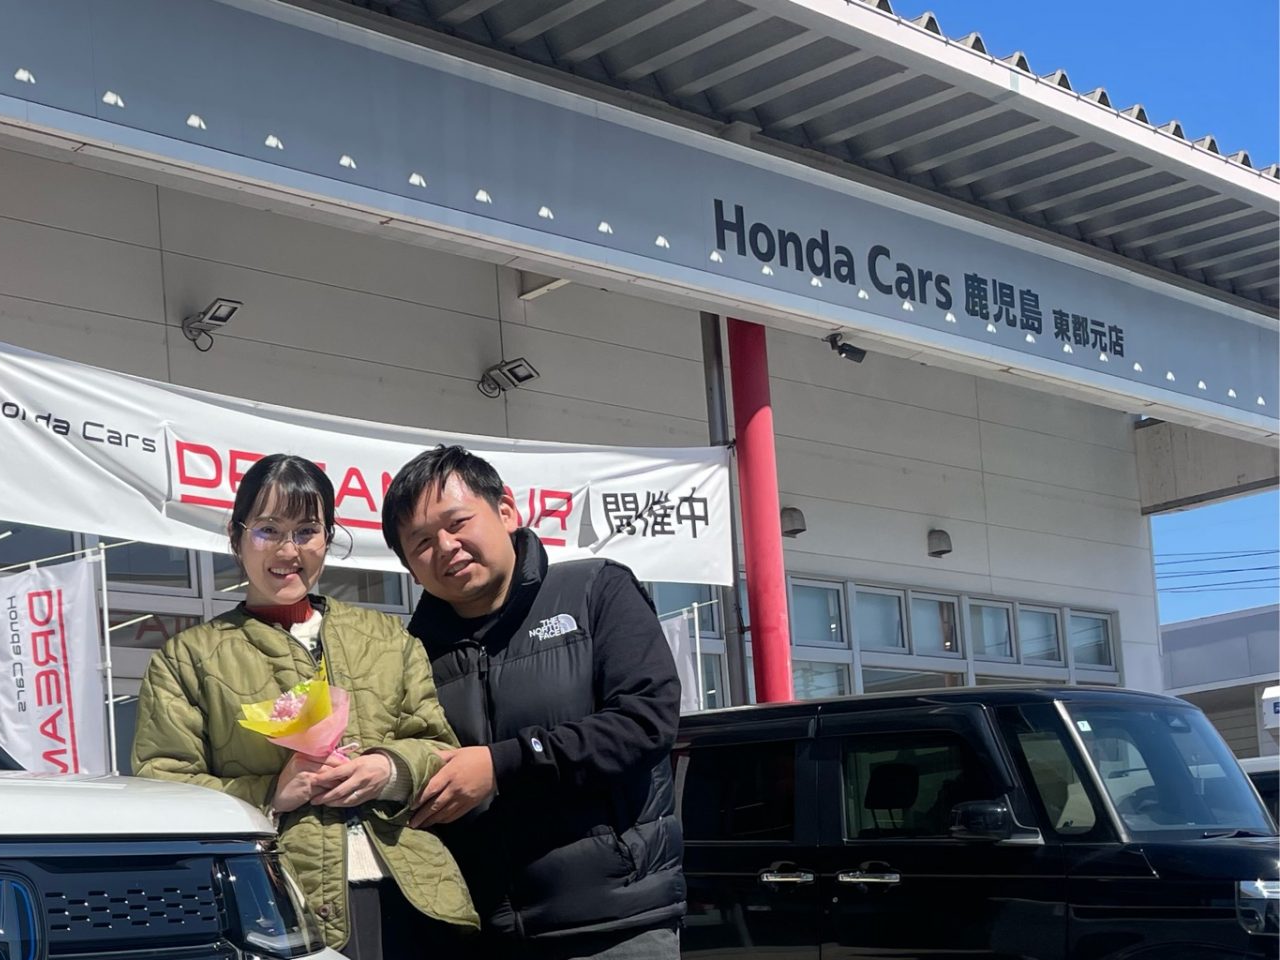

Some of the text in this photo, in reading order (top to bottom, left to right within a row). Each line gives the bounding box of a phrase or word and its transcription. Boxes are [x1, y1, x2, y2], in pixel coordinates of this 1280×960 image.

[713, 199, 1124, 357] Honda Cars 鹿児島 東郡元店
[82, 421, 157, 453] Cars
[602, 486, 710, 539] 開催中
[539, 617, 560, 627] THE
[528, 624, 560, 638] NORTH
[538, 630, 562, 641] FACE
